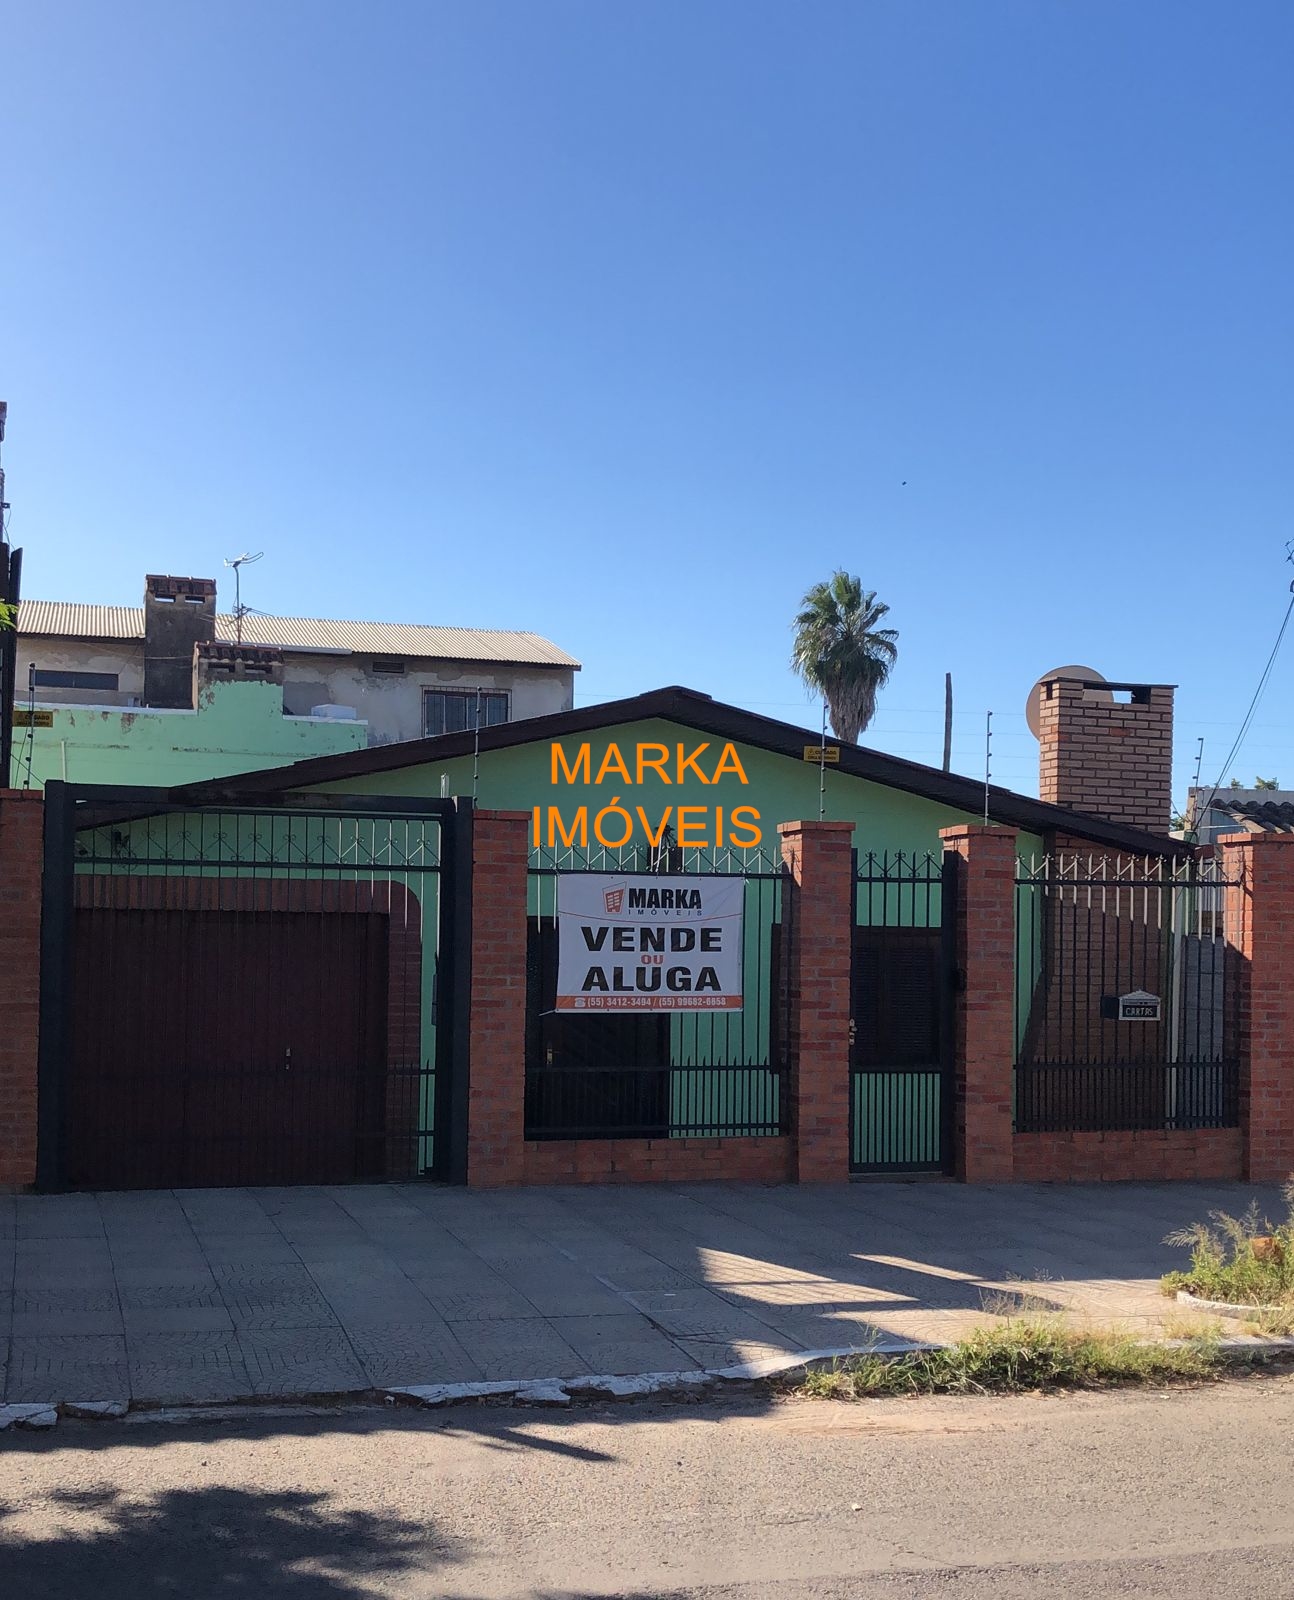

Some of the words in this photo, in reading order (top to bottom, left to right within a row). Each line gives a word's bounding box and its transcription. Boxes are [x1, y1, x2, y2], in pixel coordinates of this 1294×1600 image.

[628, 888, 702, 909] MARKA
[628, 908, 703, 916] IMÓVEIS
[581, 926, 722, 952] VENDE
[640, 954, 664, 965] OU
[581, 966, 722, 992] ALUGA
[587, 997, 604, 1007] (55)
[659, 997, 675, 1007] (55)
[1125, 1007, 1153, 1016] CARTAS
